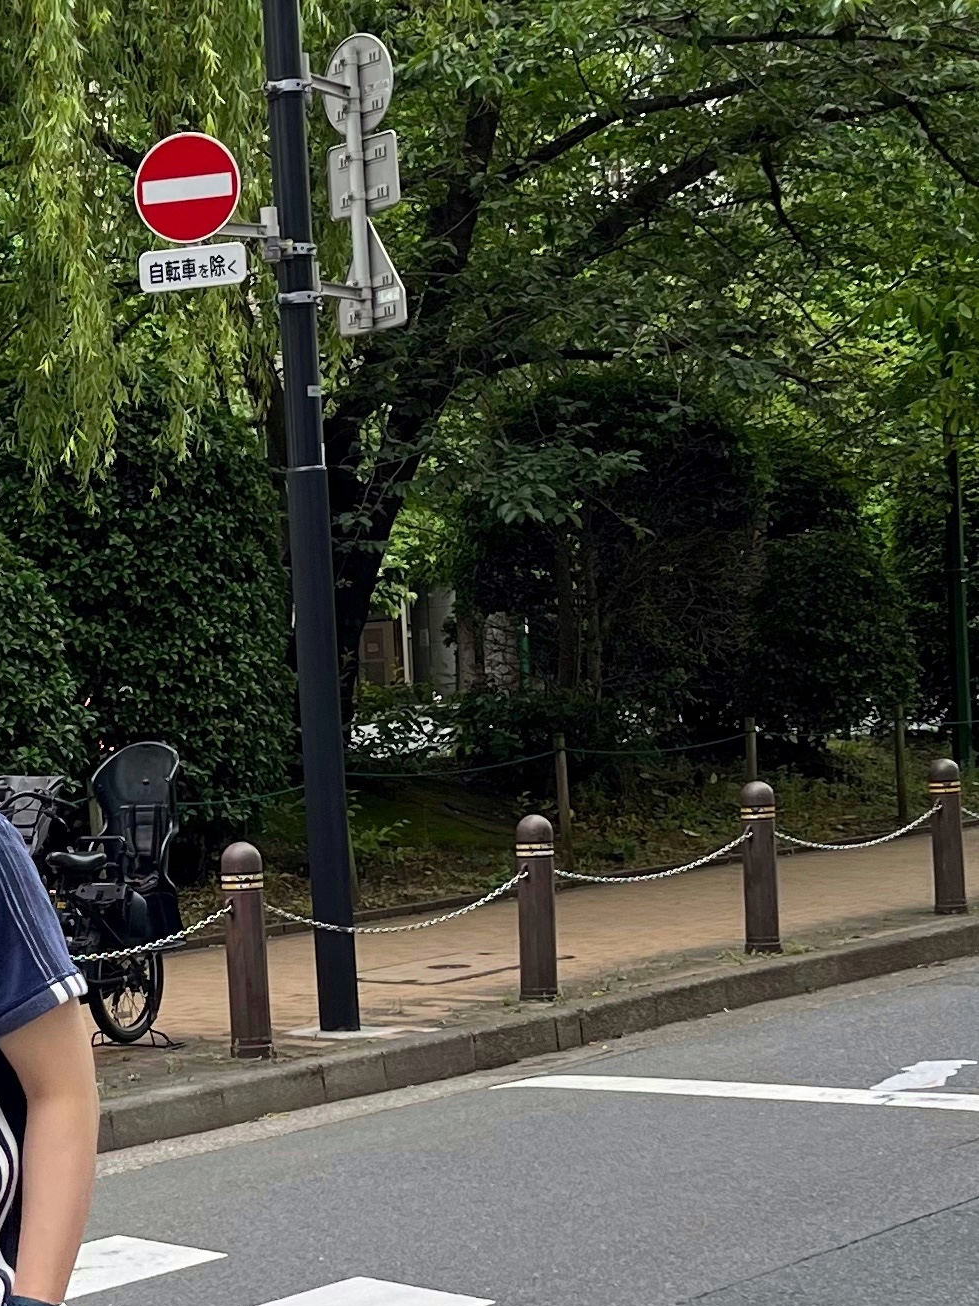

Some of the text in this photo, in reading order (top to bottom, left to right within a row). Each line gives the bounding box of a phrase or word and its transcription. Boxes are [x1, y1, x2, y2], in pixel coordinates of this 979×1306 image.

[149, 254, 238, 285] 自転車を除く
